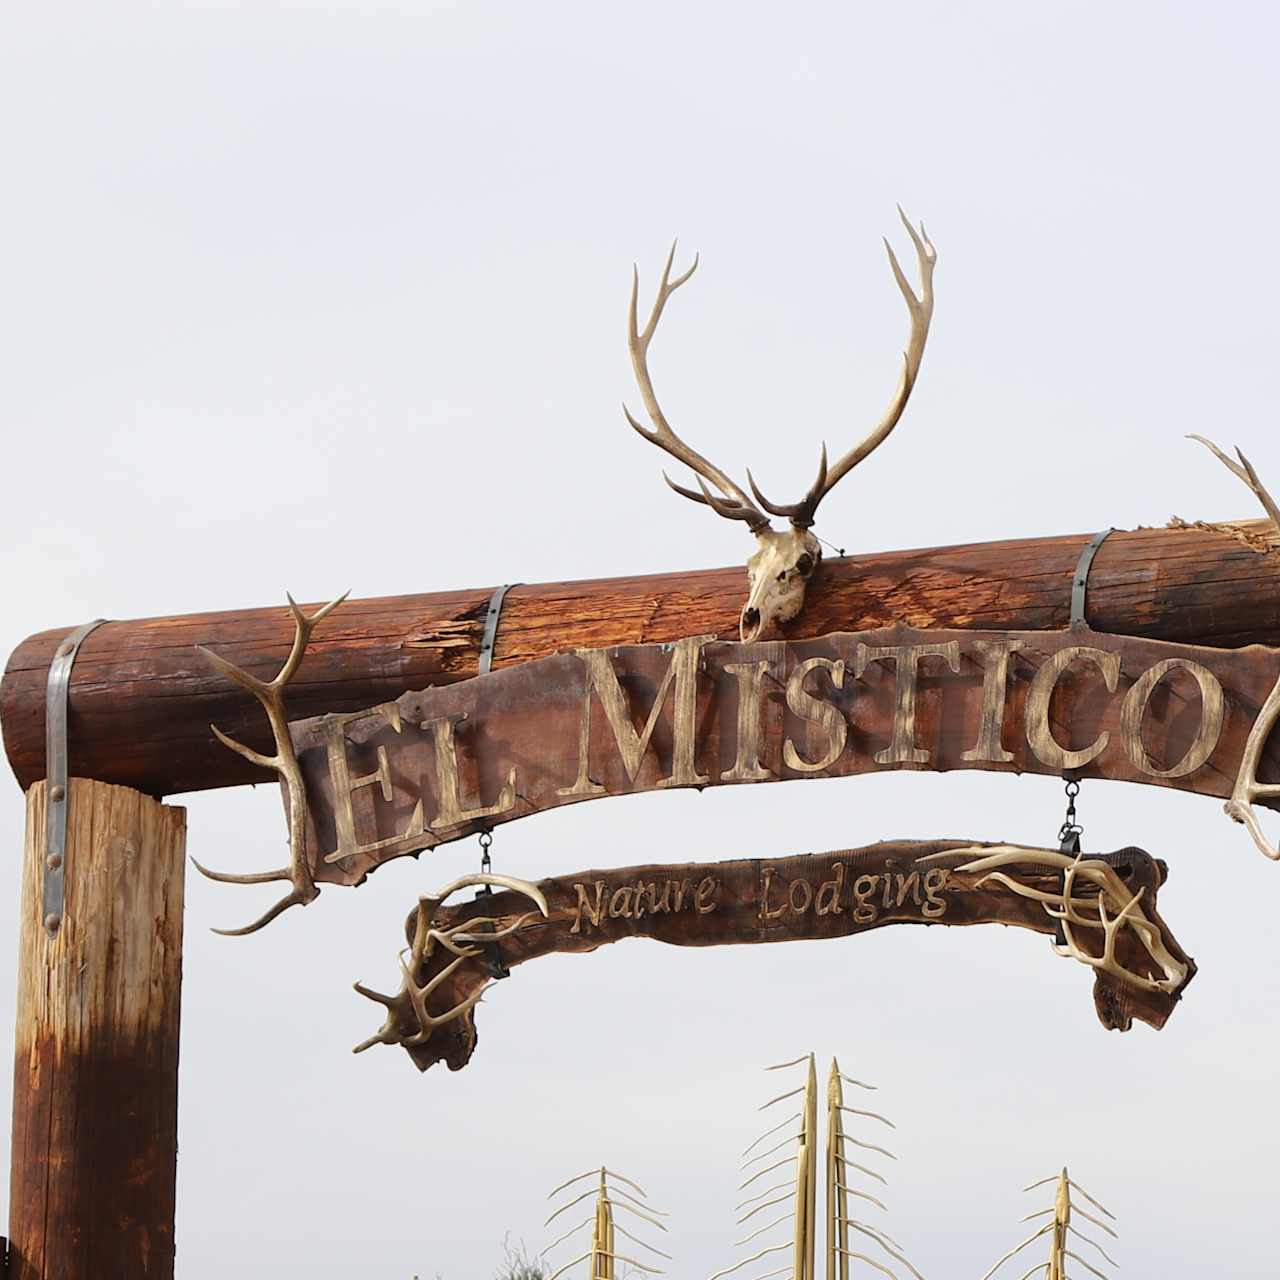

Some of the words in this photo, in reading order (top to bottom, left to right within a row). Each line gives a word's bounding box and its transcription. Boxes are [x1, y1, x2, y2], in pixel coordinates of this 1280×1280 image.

[318, 701, 517, 864] EL
[556, 633, 1224, 796] MISTICO
[570, 873, 718, 934] Nature
[757, 861, 951, 924] Lodging
